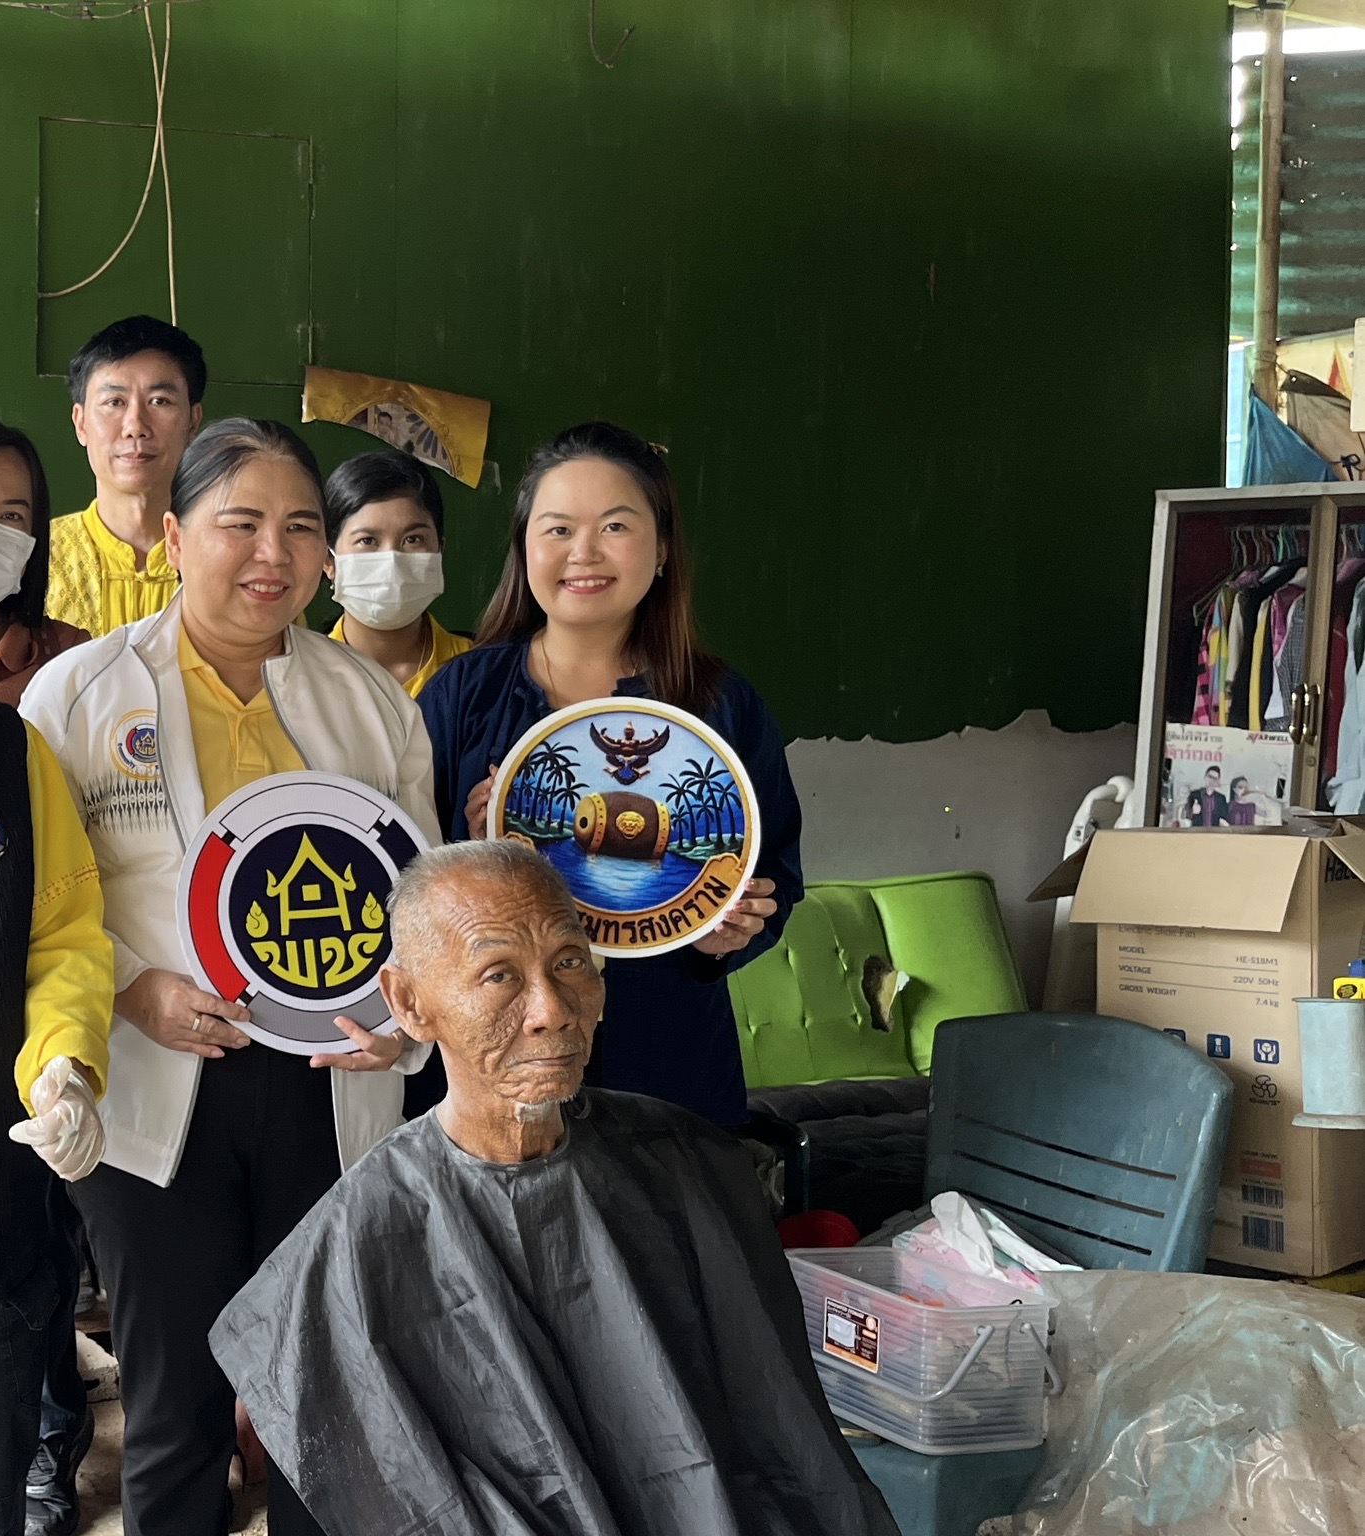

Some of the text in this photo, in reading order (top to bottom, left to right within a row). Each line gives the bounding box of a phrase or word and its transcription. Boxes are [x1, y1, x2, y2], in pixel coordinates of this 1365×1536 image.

[577, 875, 731, 944] มุทรสงคราม
[1118, 945, 1146, 955] MODEL
[1118, 964, 1152, 975] VOLTAGE
[1233, 976, 1279, 987] 220V 50Hz
[1118, 984, 1177, 997] GROSS WEIGHT
[1270, 998, 1279, 1008] kg
